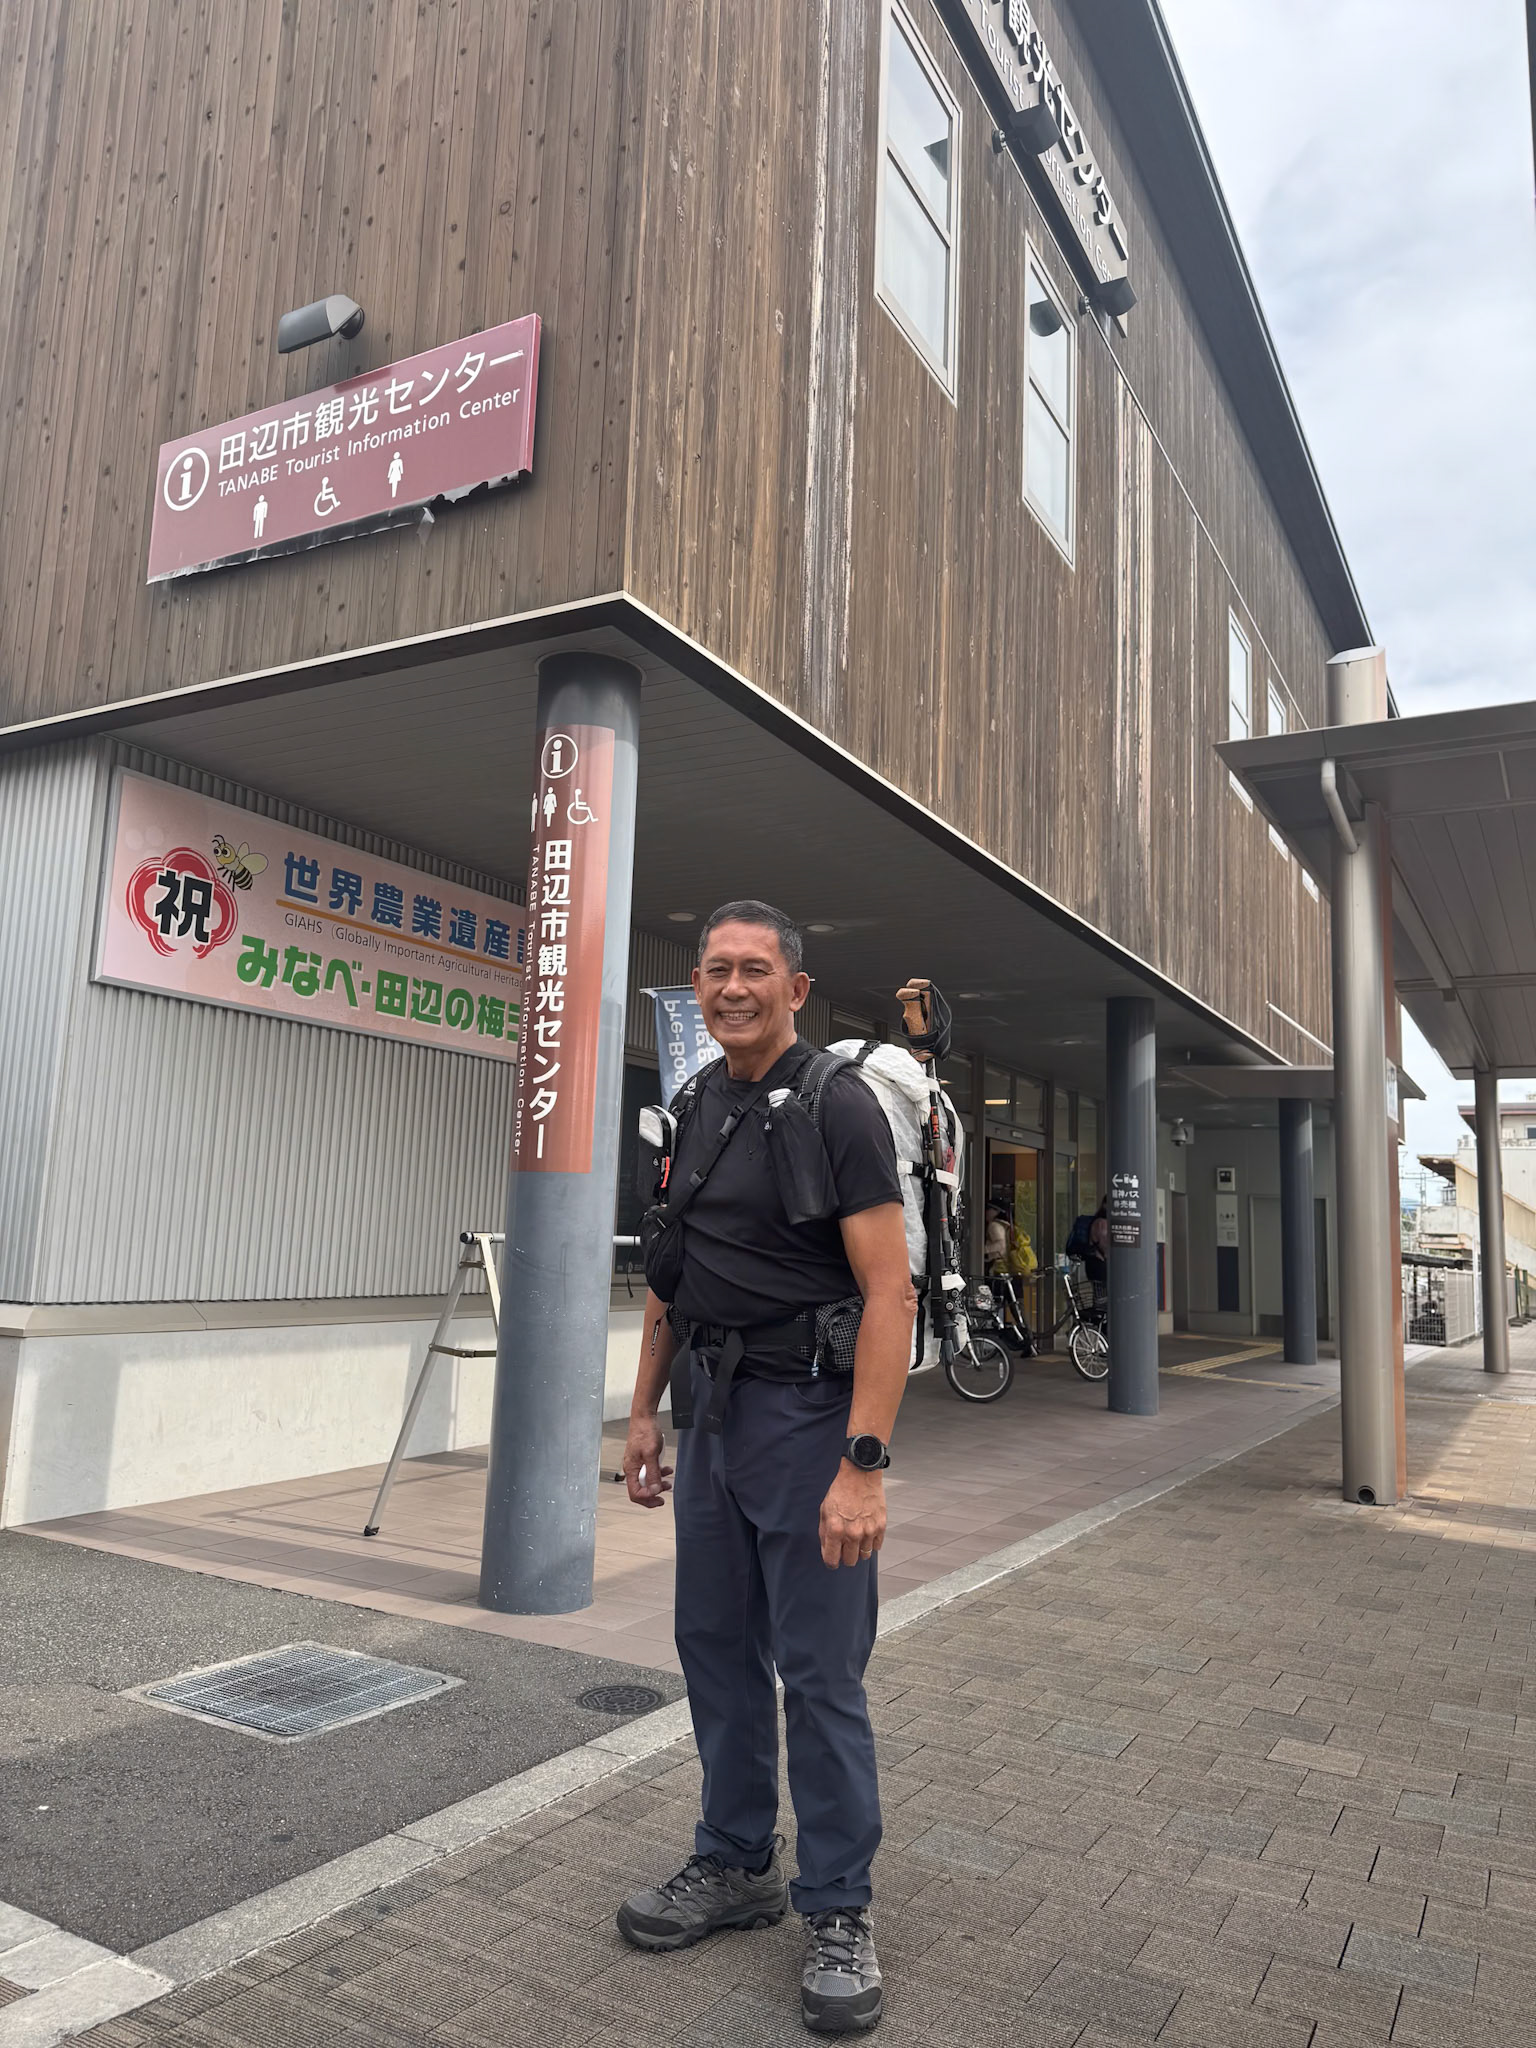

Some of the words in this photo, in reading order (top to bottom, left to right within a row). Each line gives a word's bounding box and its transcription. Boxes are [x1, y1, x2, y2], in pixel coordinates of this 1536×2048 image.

[1002, 0, 1128, 260] 観光センター
[217, 350, 524, 475] 田辺市観光センター
[218, 467, 278, 497] TANABE
[285, 446, 340, 476] Tourist
[347, 412, 450, 457] Information
[459, 387, 521, 420] Center
[154, 868, 214, 944] 祝
[529, 844, 540, 912] TANABE
[284, 912, 324, 934] GIAHS
[384, 939, 435, 966] Important
[438, 955, 492, 980] Agricultural
[524, 920, 536, 982] Tourist
[518, 991, 533, 1088] Information
[530, 839, 573, 1159] 田辺市観光センター
[514, 1098, 526, 1156] Center
